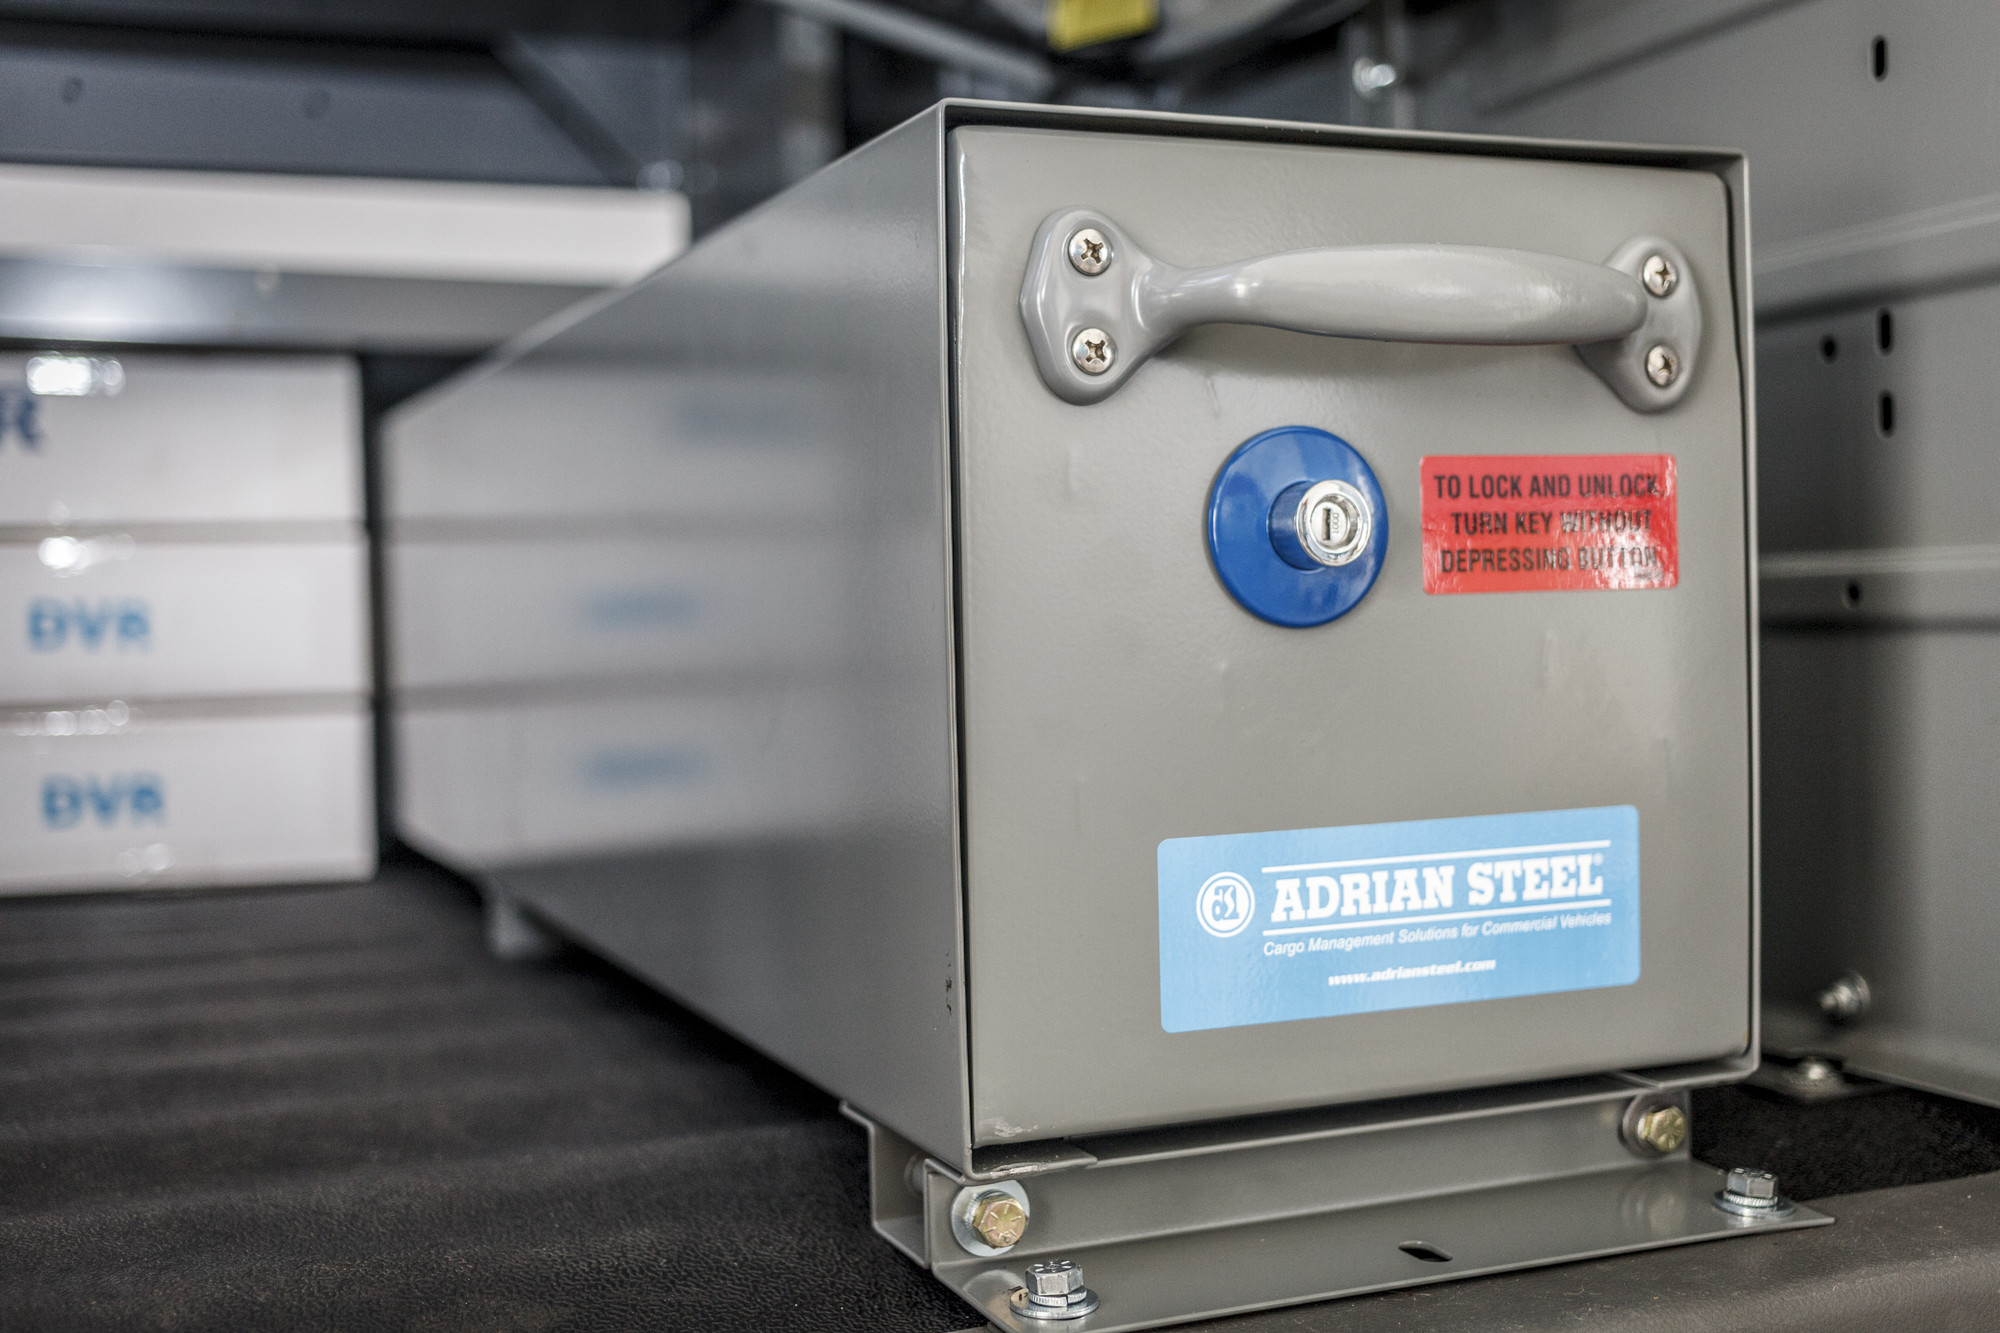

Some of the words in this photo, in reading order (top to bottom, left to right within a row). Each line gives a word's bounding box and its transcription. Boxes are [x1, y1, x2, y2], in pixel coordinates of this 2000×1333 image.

[1433, 475, 1460, 498] TO
[1469, 475, 1522, 498] LOCK
[1529, 474, 1570, 497] AND
[1451, 511, 1508, 535] TURN
[1515, 511, 1553, 535] KEY
[1560, 510, 1653, 534] WITHOUT
[1440, 548, 1571, 573] DEPRESSING
[1271, 865, 1455, 923] ADRIAN
[1263, 941, 1305, 957] Cargo
[1308, 930, 1395, 952] Management
[1398, 924, 1459, 944] Solutions
[1461, 922, 1479, 938] for
[1481, 915, 1558, 936] Commercial
[1560, 911, 1612, 929] Vehicles
[1328, 959, 1497, 986] www.adriansteel.com
